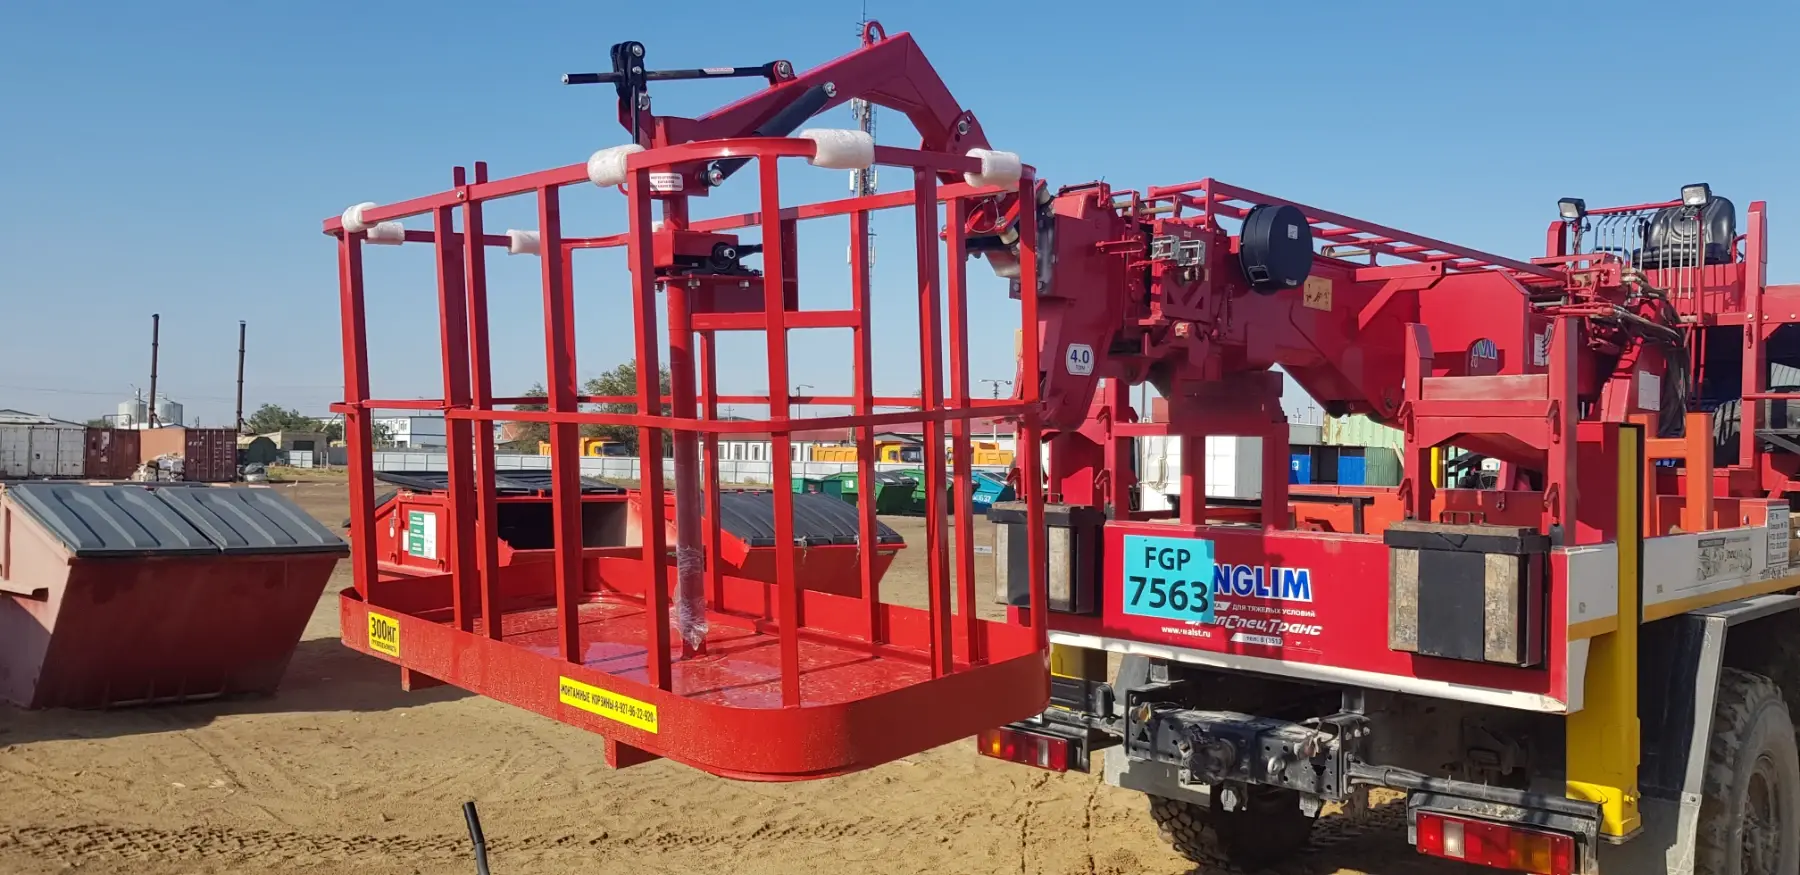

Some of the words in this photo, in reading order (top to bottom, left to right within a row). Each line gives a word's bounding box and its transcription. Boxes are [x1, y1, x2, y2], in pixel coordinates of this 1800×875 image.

[1070, 349, 1090, 364] 4.0
[1145, 546, 1191, 571] FGP
[1129, 575, 1209, 613] 7563
[1213, 563, 1313, 602] NGLIM
